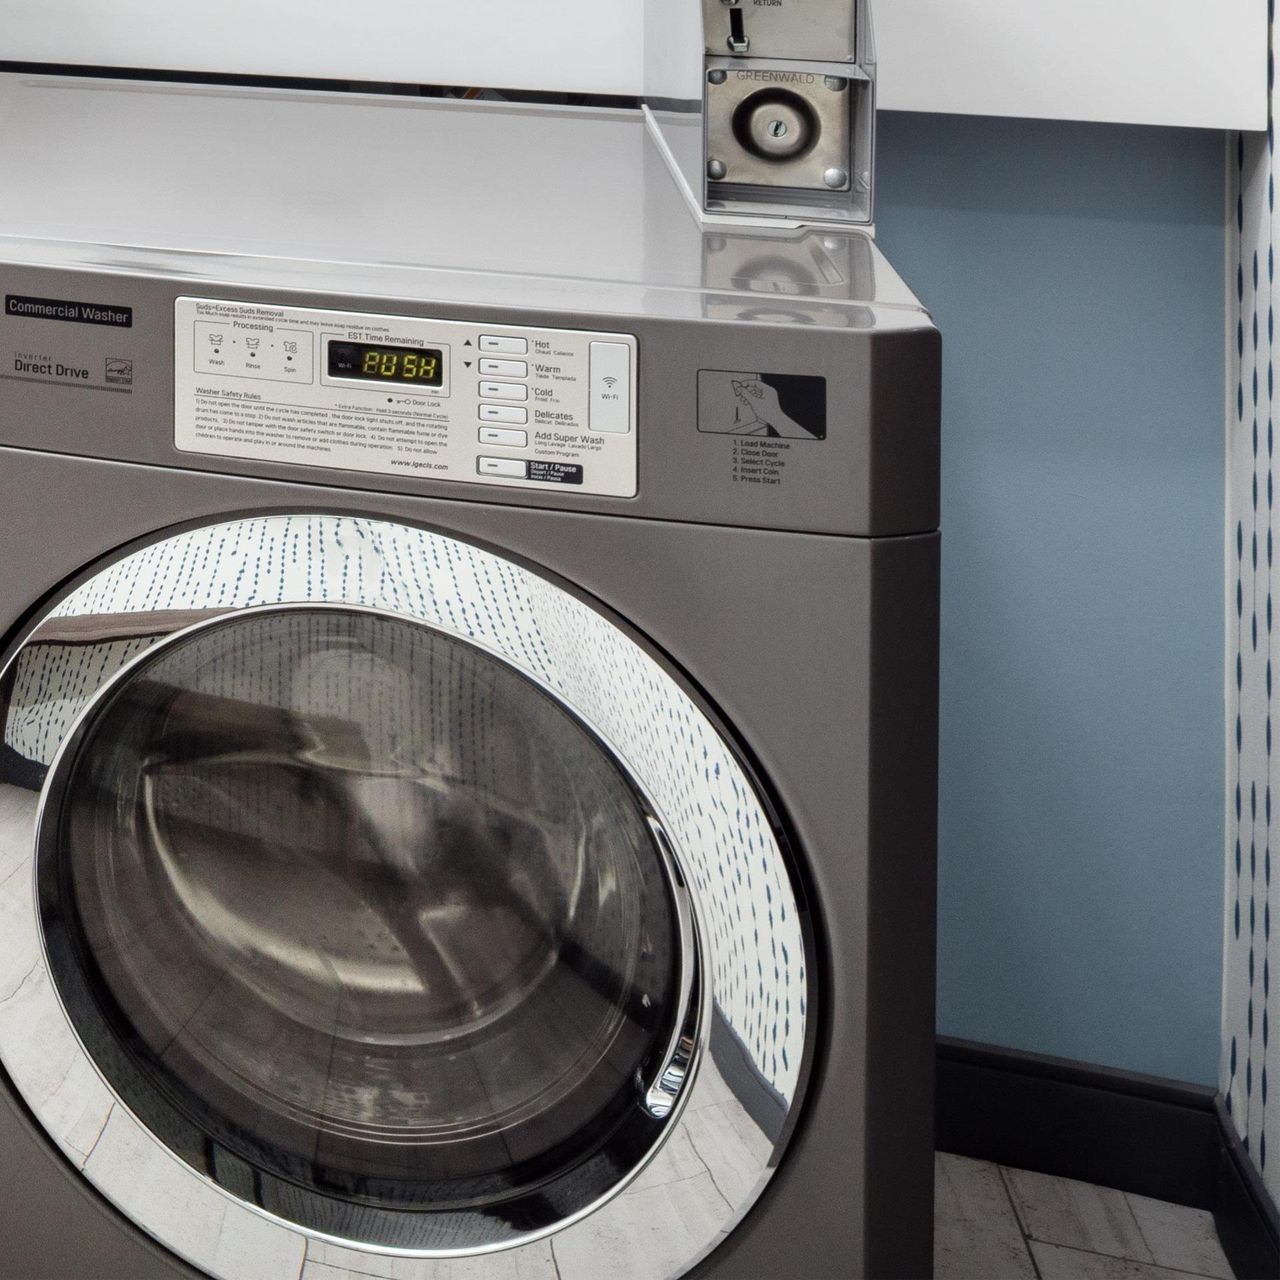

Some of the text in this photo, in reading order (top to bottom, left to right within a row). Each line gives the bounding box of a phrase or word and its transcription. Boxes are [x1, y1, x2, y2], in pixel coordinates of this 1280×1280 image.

[736, 70, 815, 84] GREENWALD
[9, 300, 128, 323] Commercial Washer
[256, 309, 283, 317] Removal
[233, 321, 273, 332] Processing
[365, 333, 382, 341] Time
[384, 335, 424, 346] Remaining
[534, 340, 549, 348] Hot
[14, 359, 88, 379] Direct Drive
[362, 351, 436, 378] PUSH
[534, 364, 560, 373] Warm
[284, 366, 296, 374] Spin
[196, 387, 261, 400] Washer Safety Rules
[534, 388, 552, 396] Cold
[534, 410, 573, 420] Delicates
[534, 432, 604, 444] Add Super Wash
[530, 462, 548, 470] Start
[554, 464, 576, 472] Pause
[762, 477, 780, 485] Start
